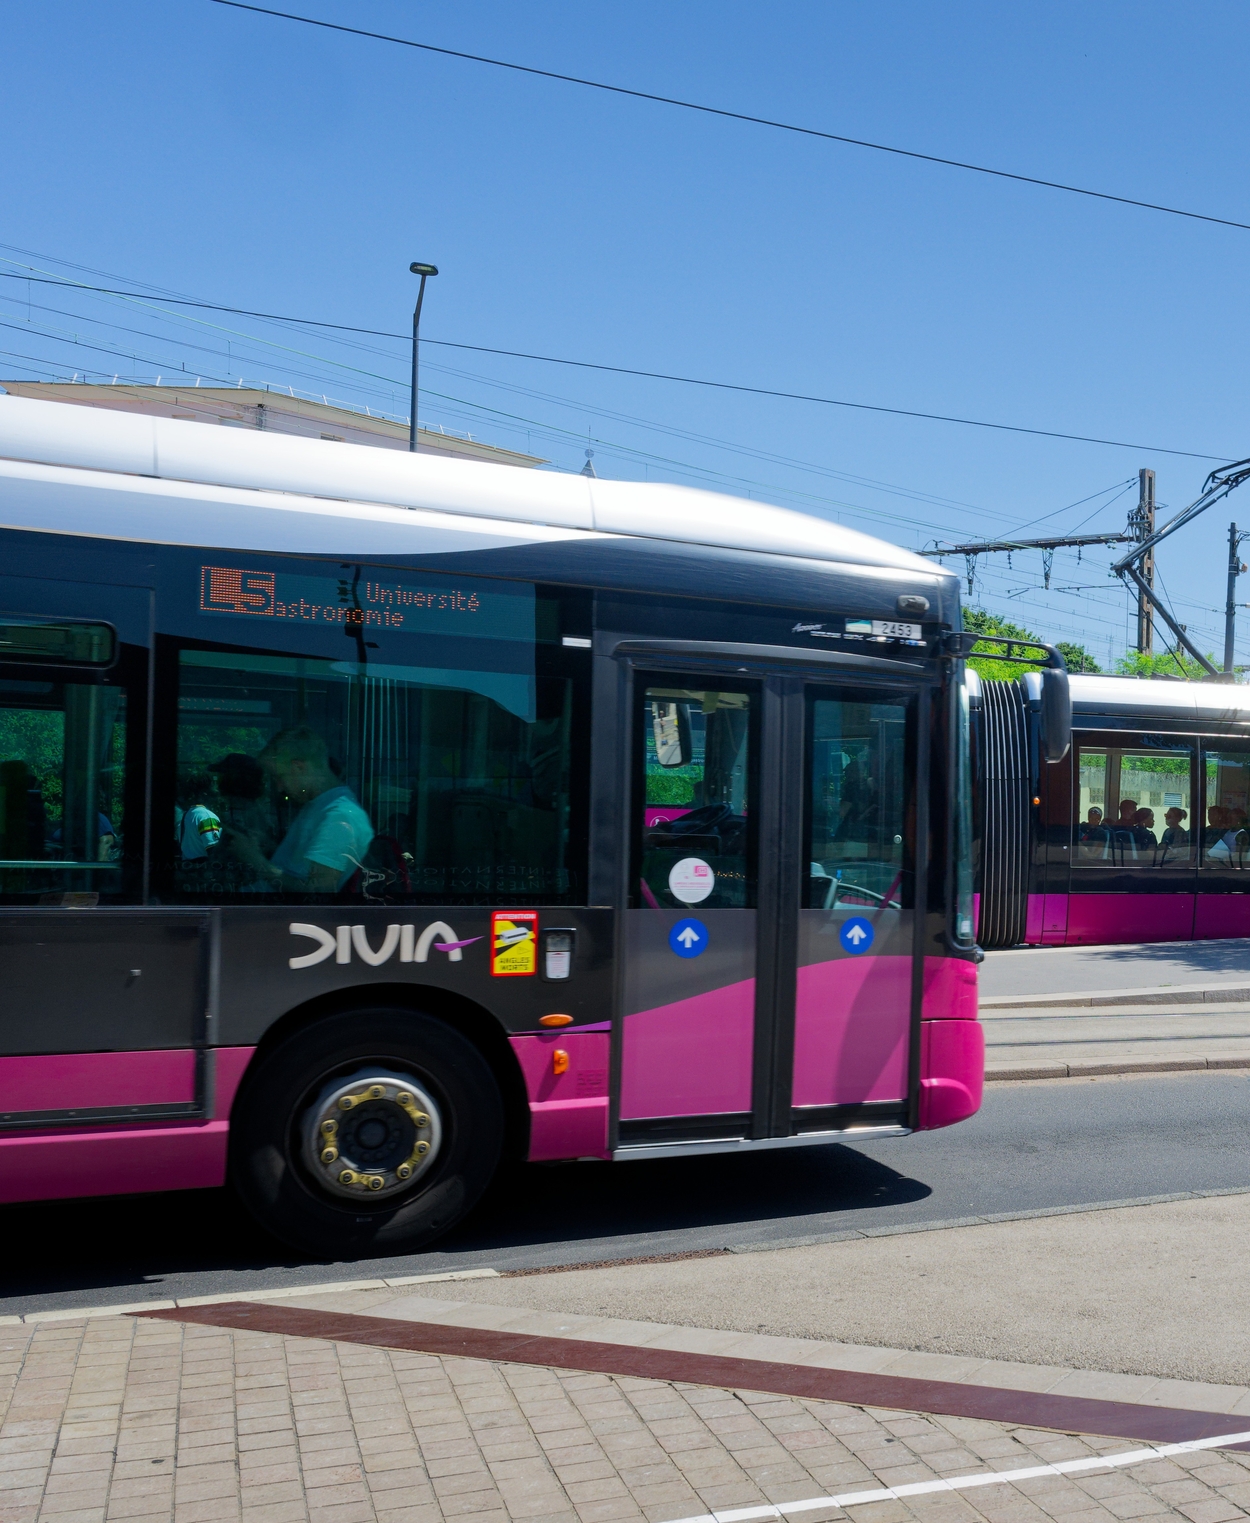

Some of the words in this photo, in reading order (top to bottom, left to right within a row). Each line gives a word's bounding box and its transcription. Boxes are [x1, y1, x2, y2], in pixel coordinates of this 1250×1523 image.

[366, 581, 480, 612] Université
[882, 622, 912, 637] 2453
[289, 920, 485, 970] DIVIA
